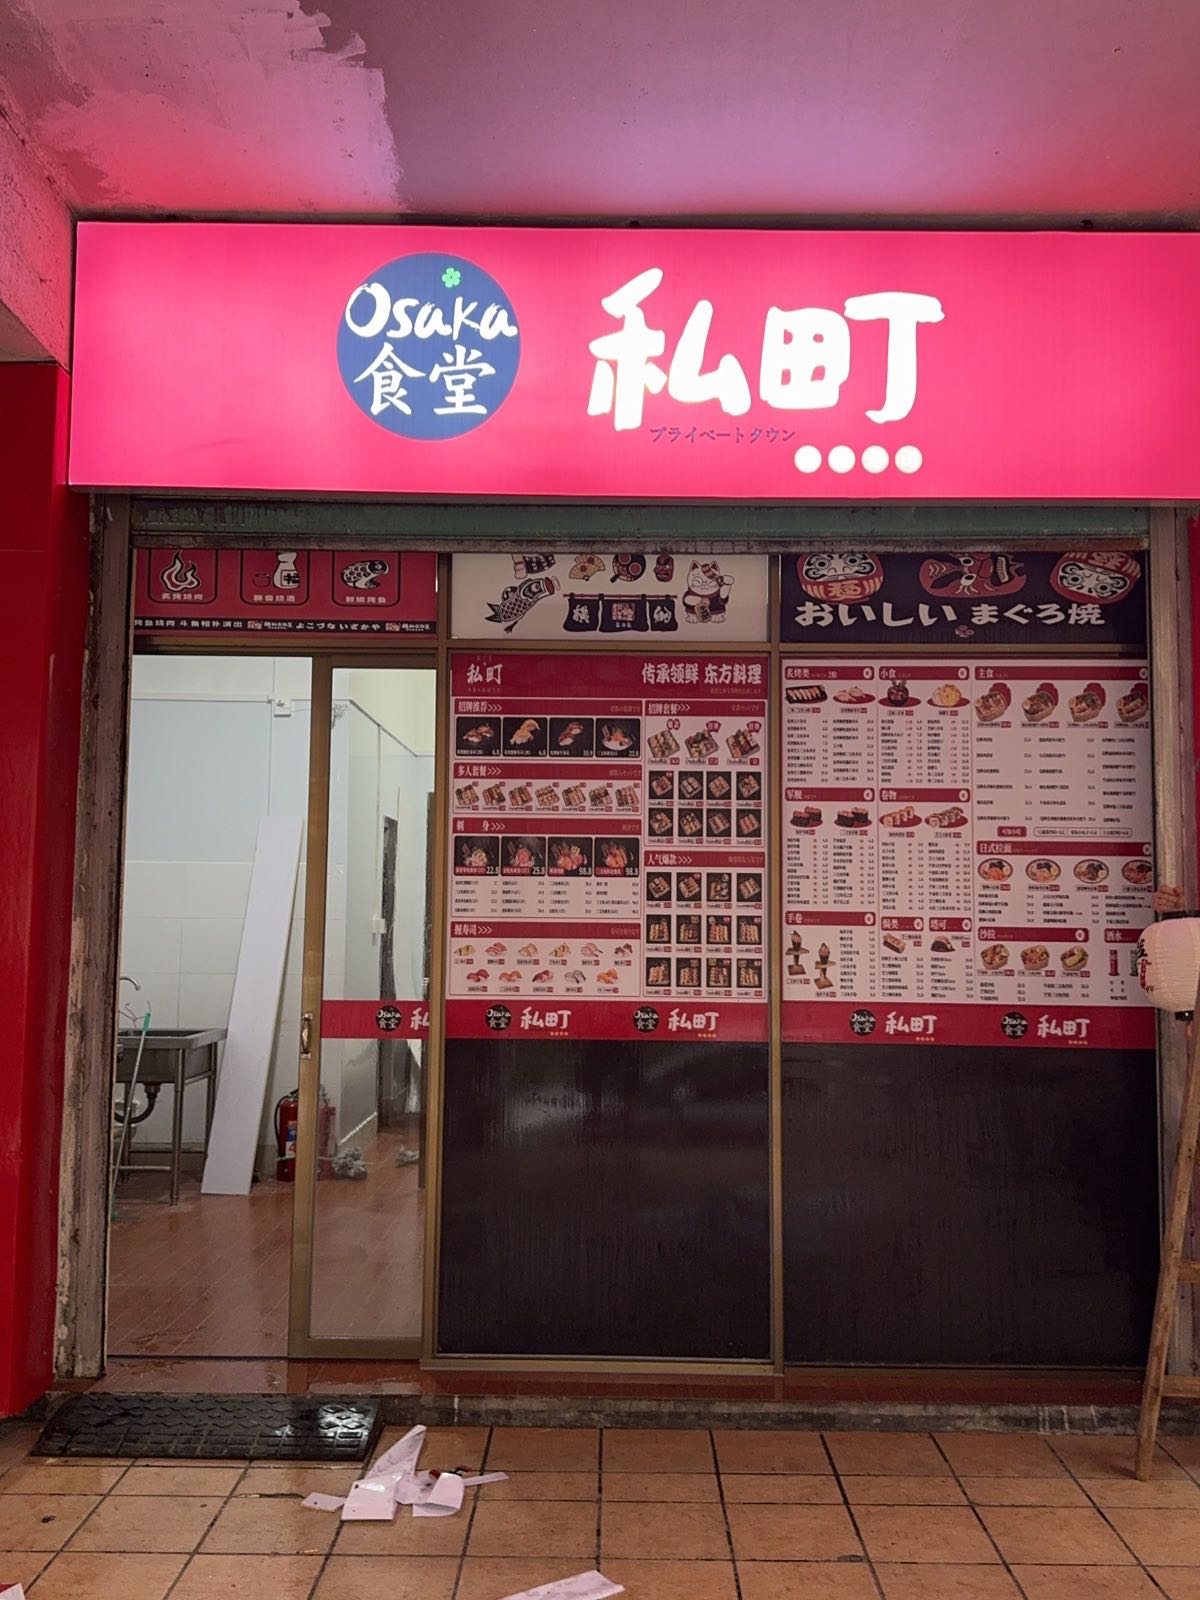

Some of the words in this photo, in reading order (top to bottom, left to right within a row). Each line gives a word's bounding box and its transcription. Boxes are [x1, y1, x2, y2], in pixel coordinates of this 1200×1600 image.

[345, 283, 518, 342] Osaka
[587, 267, 945, 430] 私町
[352, 342, 496, 416] 食堂
[650, 426, 796, 443] プライベートタウン
[794, 601, 957, 627] おいしい
[970, 602, 1106, 626] まぐろ焼
[466, 663, 504, 686] 私町
[641, 663, 699, 686] 传承领鲜
[704, 663, 763, 686] 东方料理
[880, 668, 897, 679] 小食
[978, 668, 994, 679] 主食
[458, 700, 488, 712] 招牌推荐
[457, 765, 487, 776] 多人套餐
[979, 843, 1012, 854] 日式拉面
[486, 866, 500, 874] 22.8
[532, 866, 545, 874] 25.8
[578, 867, 592, 875] 98.8
[625, 867, 640, 875] 98.8
[979, 929, 996, 940] 沙拉
[520, 1006, 572, 1030] 私町
[668, 1008, 720, 1031] 私町
[885, 1011, 938, 1035] 私町
[1037, 1014, 1091, 1038] 私町
